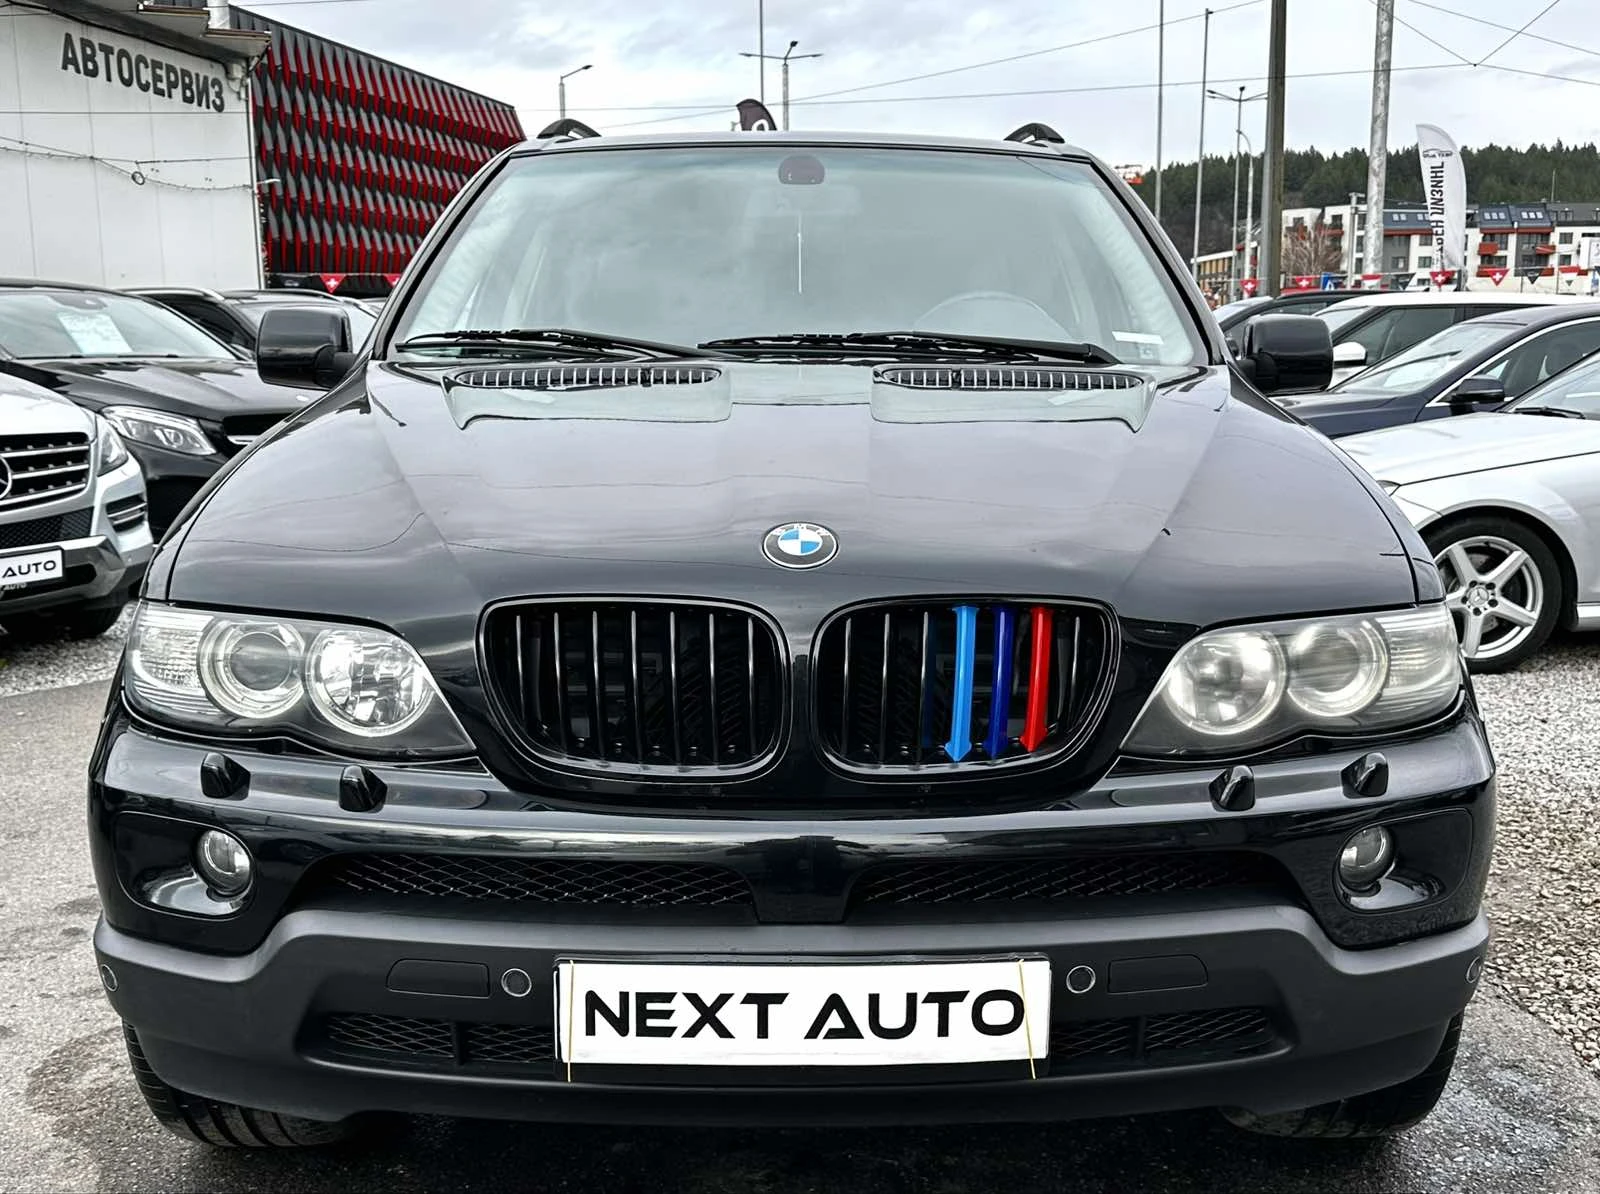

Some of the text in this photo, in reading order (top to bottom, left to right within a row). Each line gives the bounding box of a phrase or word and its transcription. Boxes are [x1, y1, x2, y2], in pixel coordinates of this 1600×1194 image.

[61, 32, 225, 113] АВТОСЕРВИЗ
[2, 560, 56, 578] AUTO
[584, 988, 1025, 1040] NEXT AUTO
